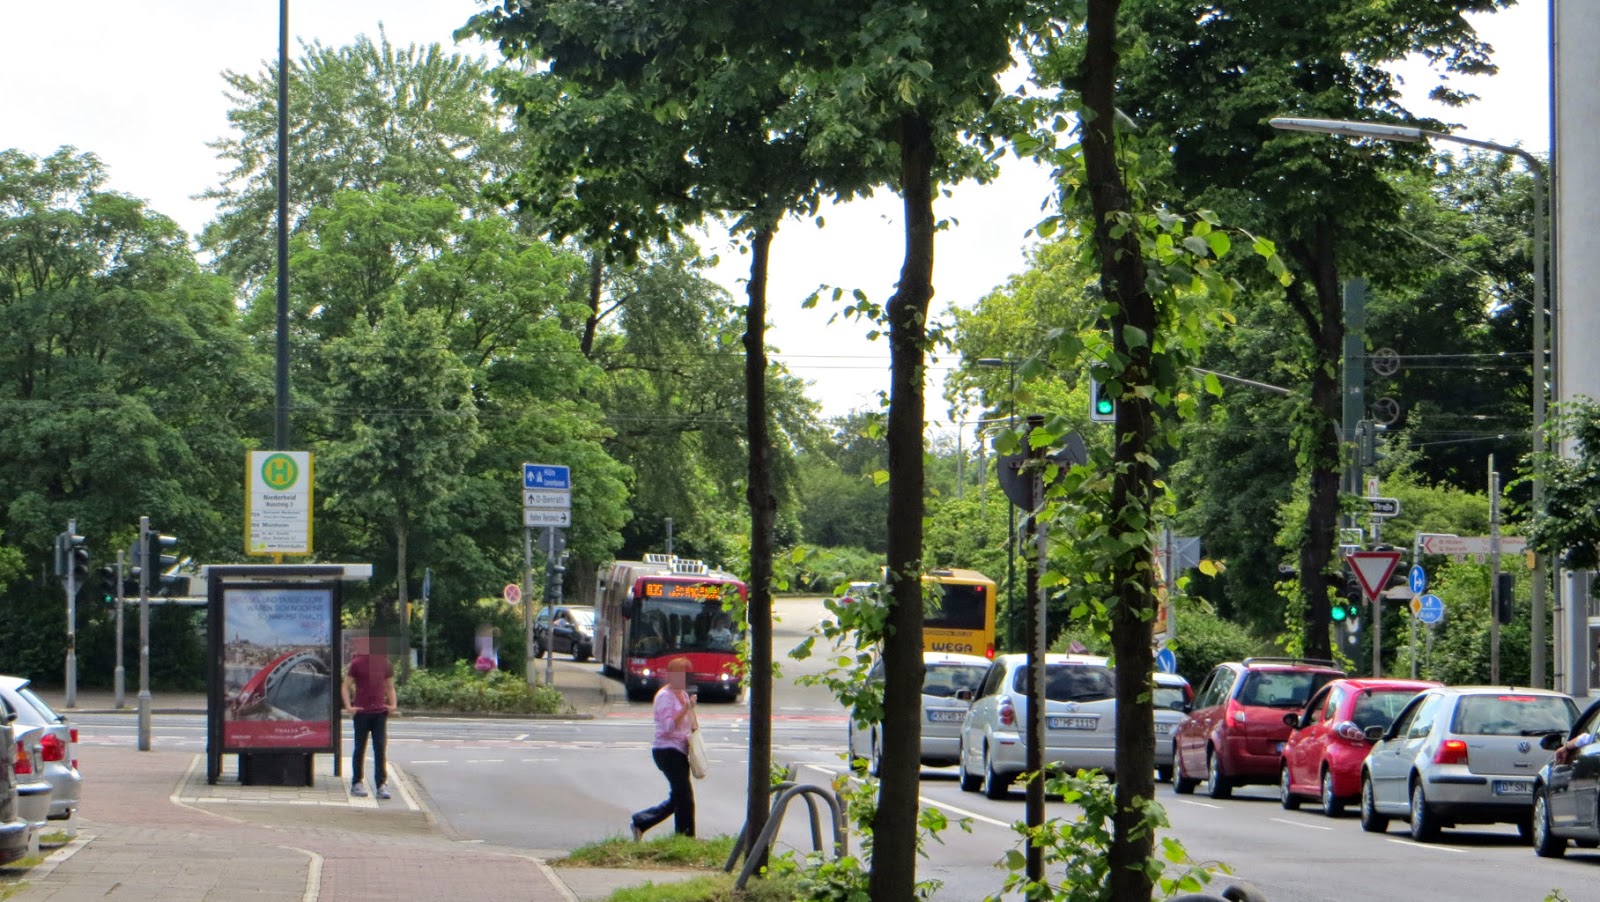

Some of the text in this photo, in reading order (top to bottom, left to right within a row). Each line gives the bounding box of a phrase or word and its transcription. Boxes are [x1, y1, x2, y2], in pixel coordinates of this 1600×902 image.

[271, 461, 288, 481] H
[1373, 502, 1393, 511] Straße
[931, 642, 973, 653] WEGA
[1502, 782, 1509, 792] D
[1515, 782, 1527, 792] SN
